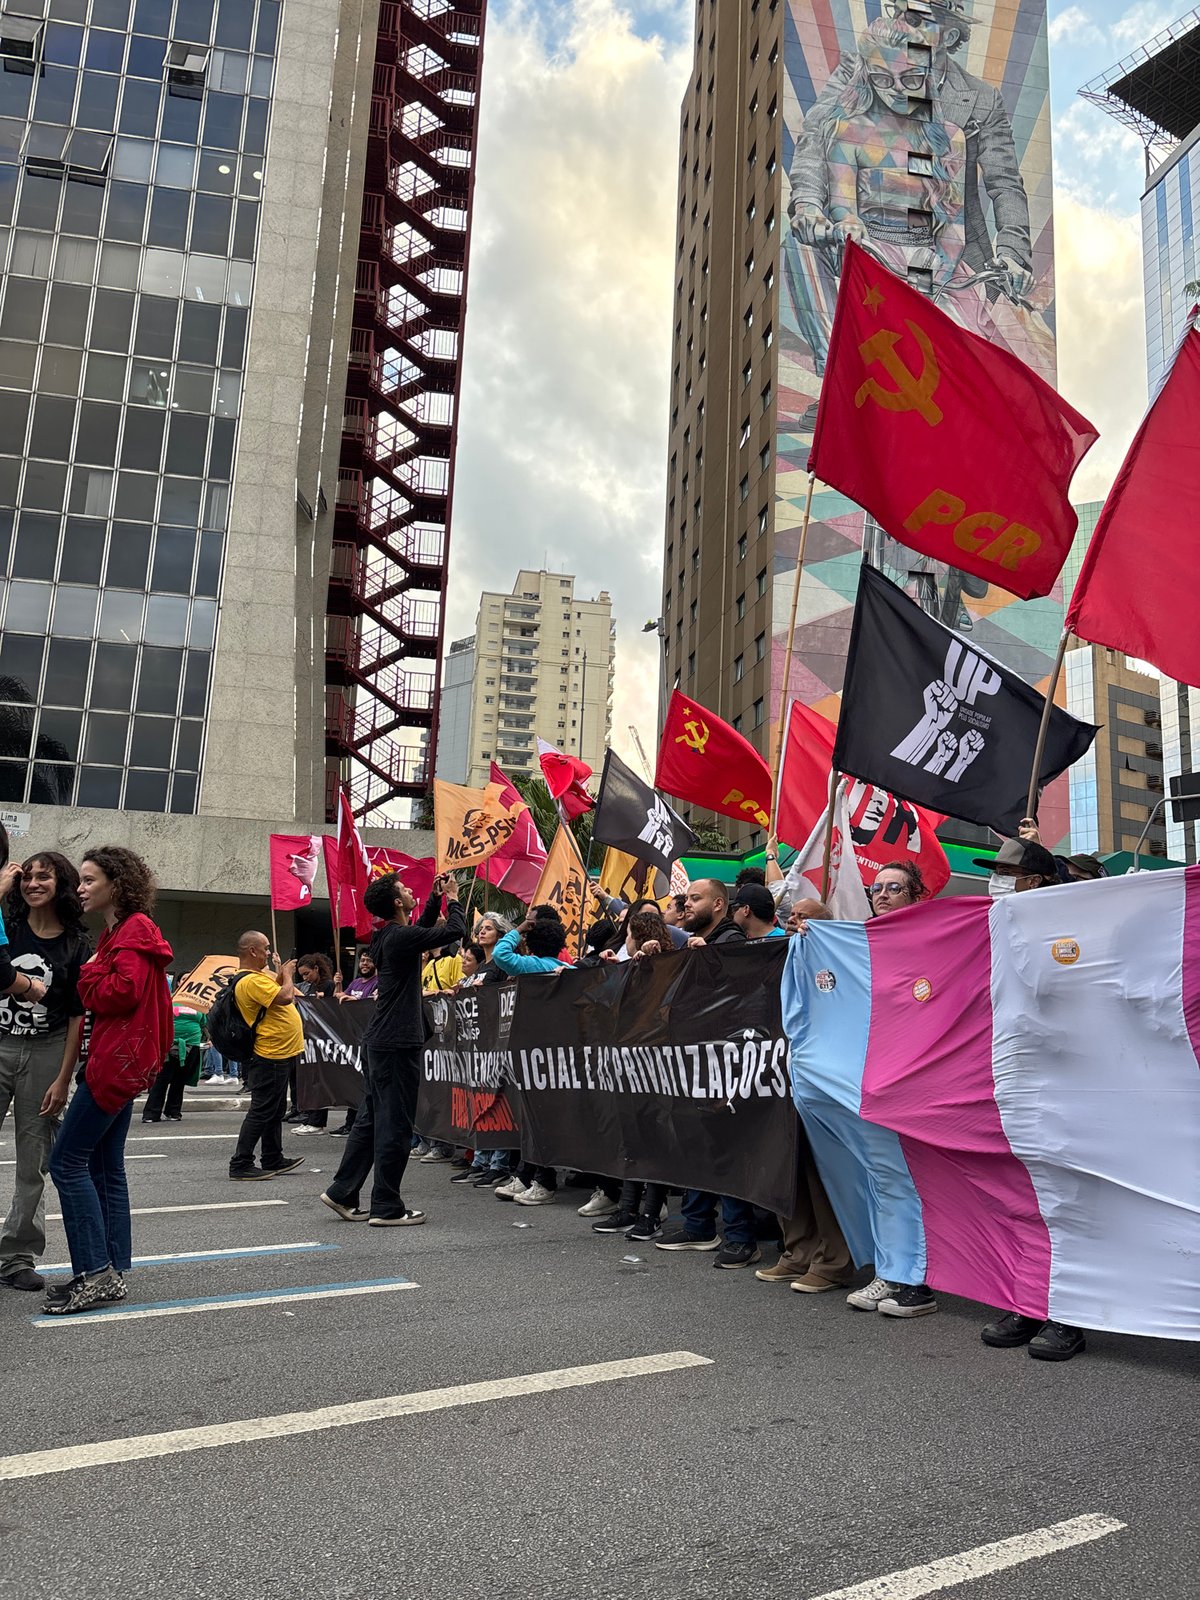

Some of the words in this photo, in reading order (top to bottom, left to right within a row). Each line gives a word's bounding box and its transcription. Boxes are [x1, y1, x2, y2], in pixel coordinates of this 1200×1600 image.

[902, 488, 1042, 572] PCR
[944, 638, 1002, 706] UP
[1, 812, 18, 823] Lima
[182, 981, 217, 1003] ME
[0, 1007, 49, 1028] DCE
[11, 1025, 38, 1035] livre
[584, 1046, 595, 1090] E
